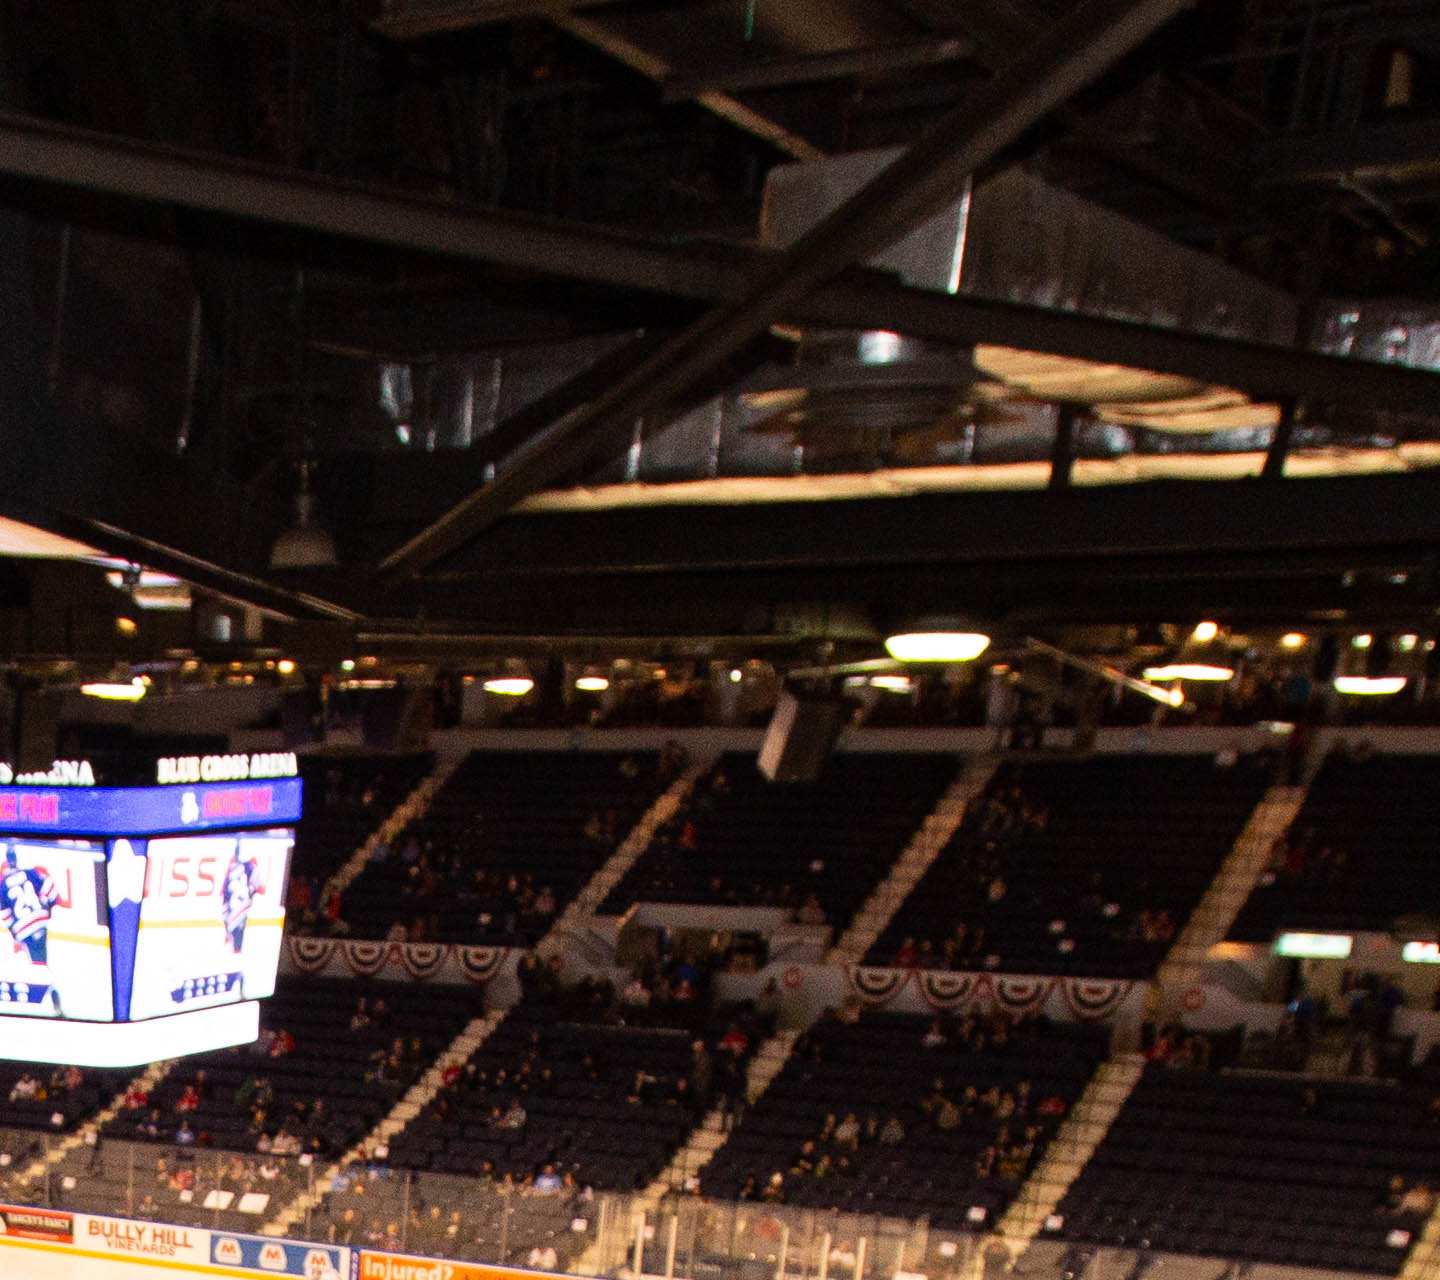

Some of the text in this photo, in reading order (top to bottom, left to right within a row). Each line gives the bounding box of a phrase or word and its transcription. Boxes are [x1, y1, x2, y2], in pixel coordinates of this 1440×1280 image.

[88, 1219, 193, 1249] BULLY HILL
[105, 1238, 176, 1257] VINEYARDS
